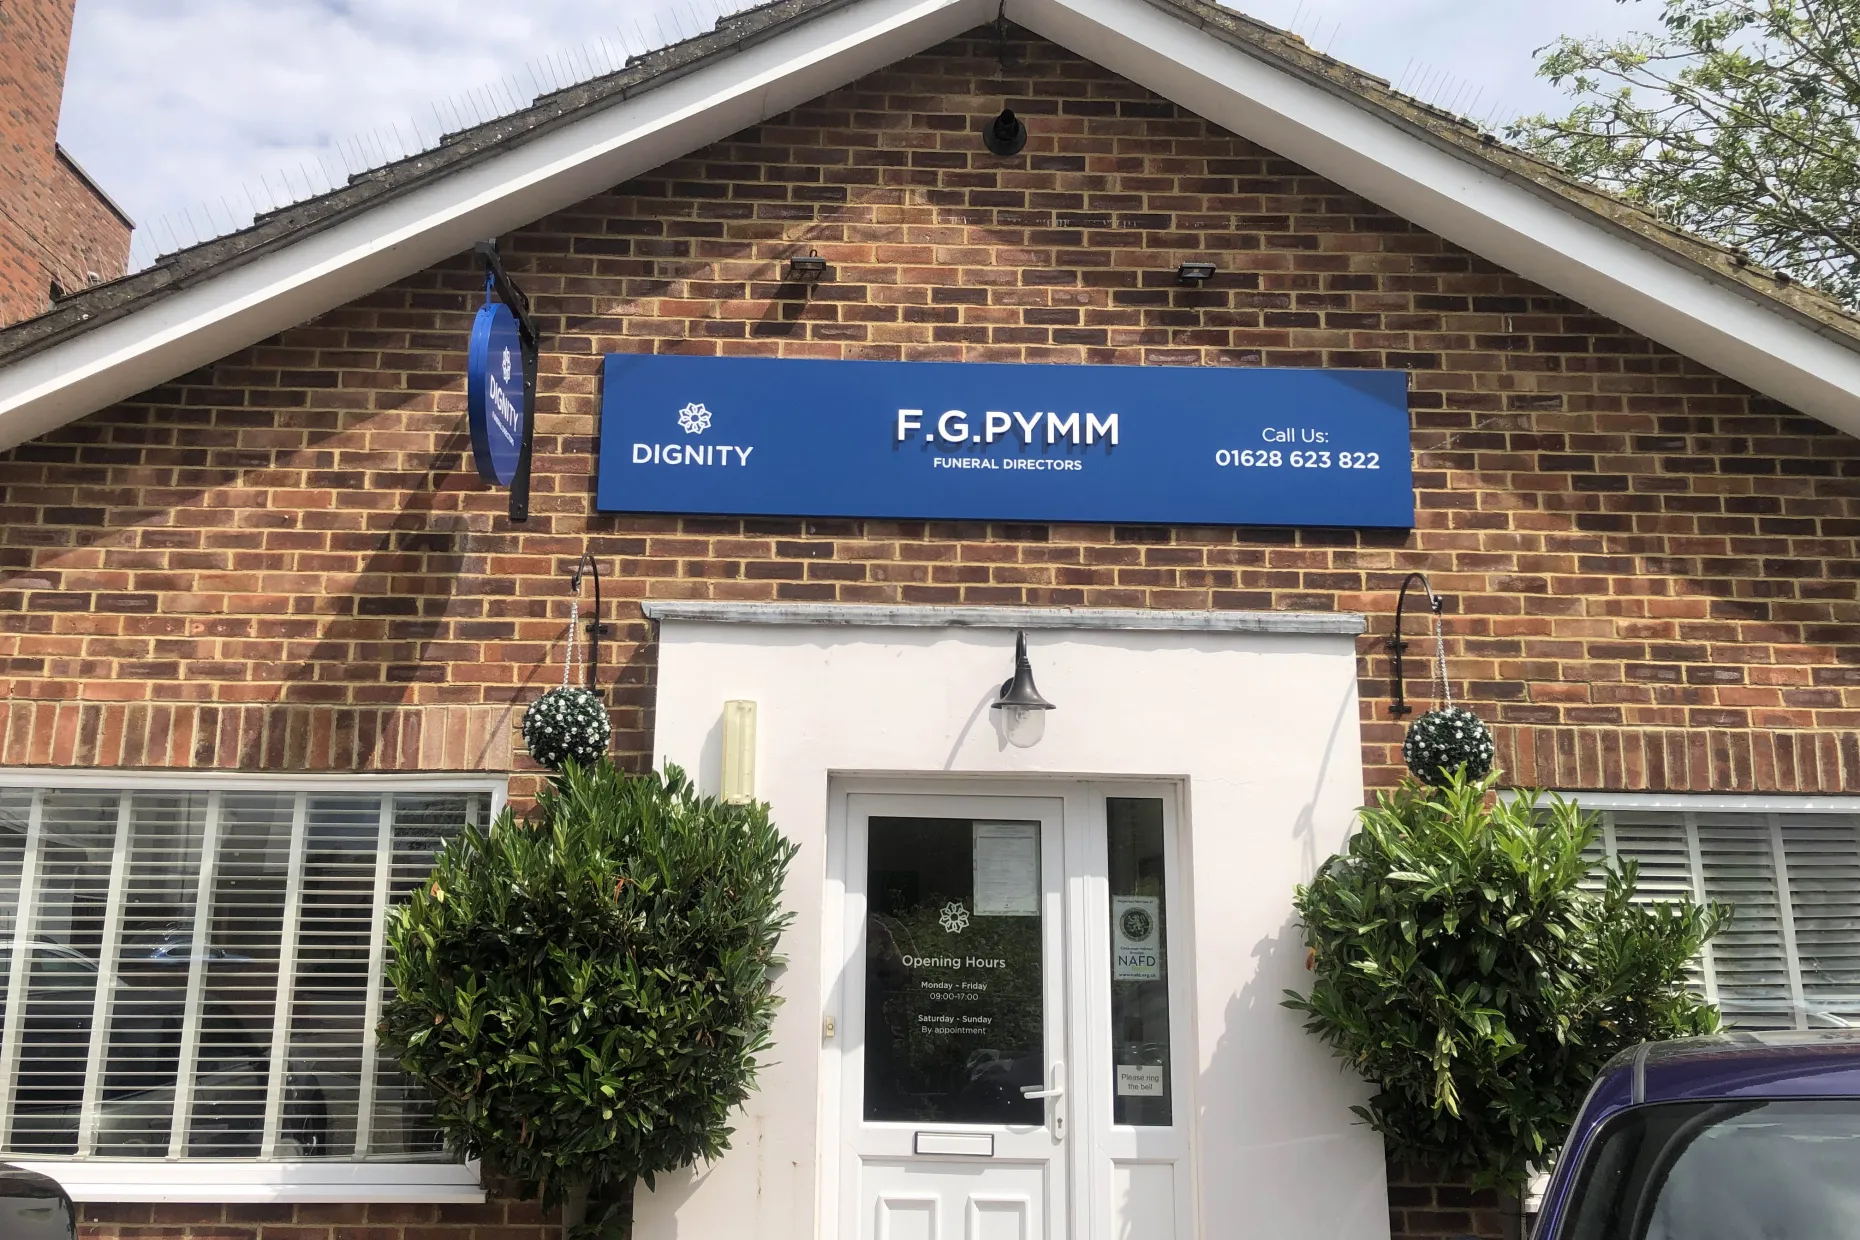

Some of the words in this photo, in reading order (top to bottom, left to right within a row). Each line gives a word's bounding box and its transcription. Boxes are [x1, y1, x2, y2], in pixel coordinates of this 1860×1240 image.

[490, 374, 519, 432] DIGNITY
[897, 408, 1119, 445] F.G.PYMM
[1261, 427, 1296, 443] Call
[1301, 428, 1329, 443] Us:
[632, 443, 754, 467] DIGNITY
[1215, 449, 1283, 468] 01628
[1289, 450, 1332, 469] 623
[1338, 451, 1380, 469] 822
[933, 457, 1000, 470] FUNERAL
[1003, 458, 1083, 471] DIRECTORS
[902, 954, 961, 970] Opening
[965, 955, 1006, 968] Hours
[1118, 955, 1156, 967] NAFD
[921, 981, 953, 991] Monday
[961, 981, 988, 991] Friday
[929, 992, 979, 1001] 09:00-17:00
[918, 1014, 955, 1024] Saturday
[962, 1015, 993, 1025] Sunday
[921, 1025, 932, 1035] By
[934, 1026, 986, 1035] appointment
[1121, 1073, 1145, 1081] Please
[1140, 1083, 1153, 1091] bell
